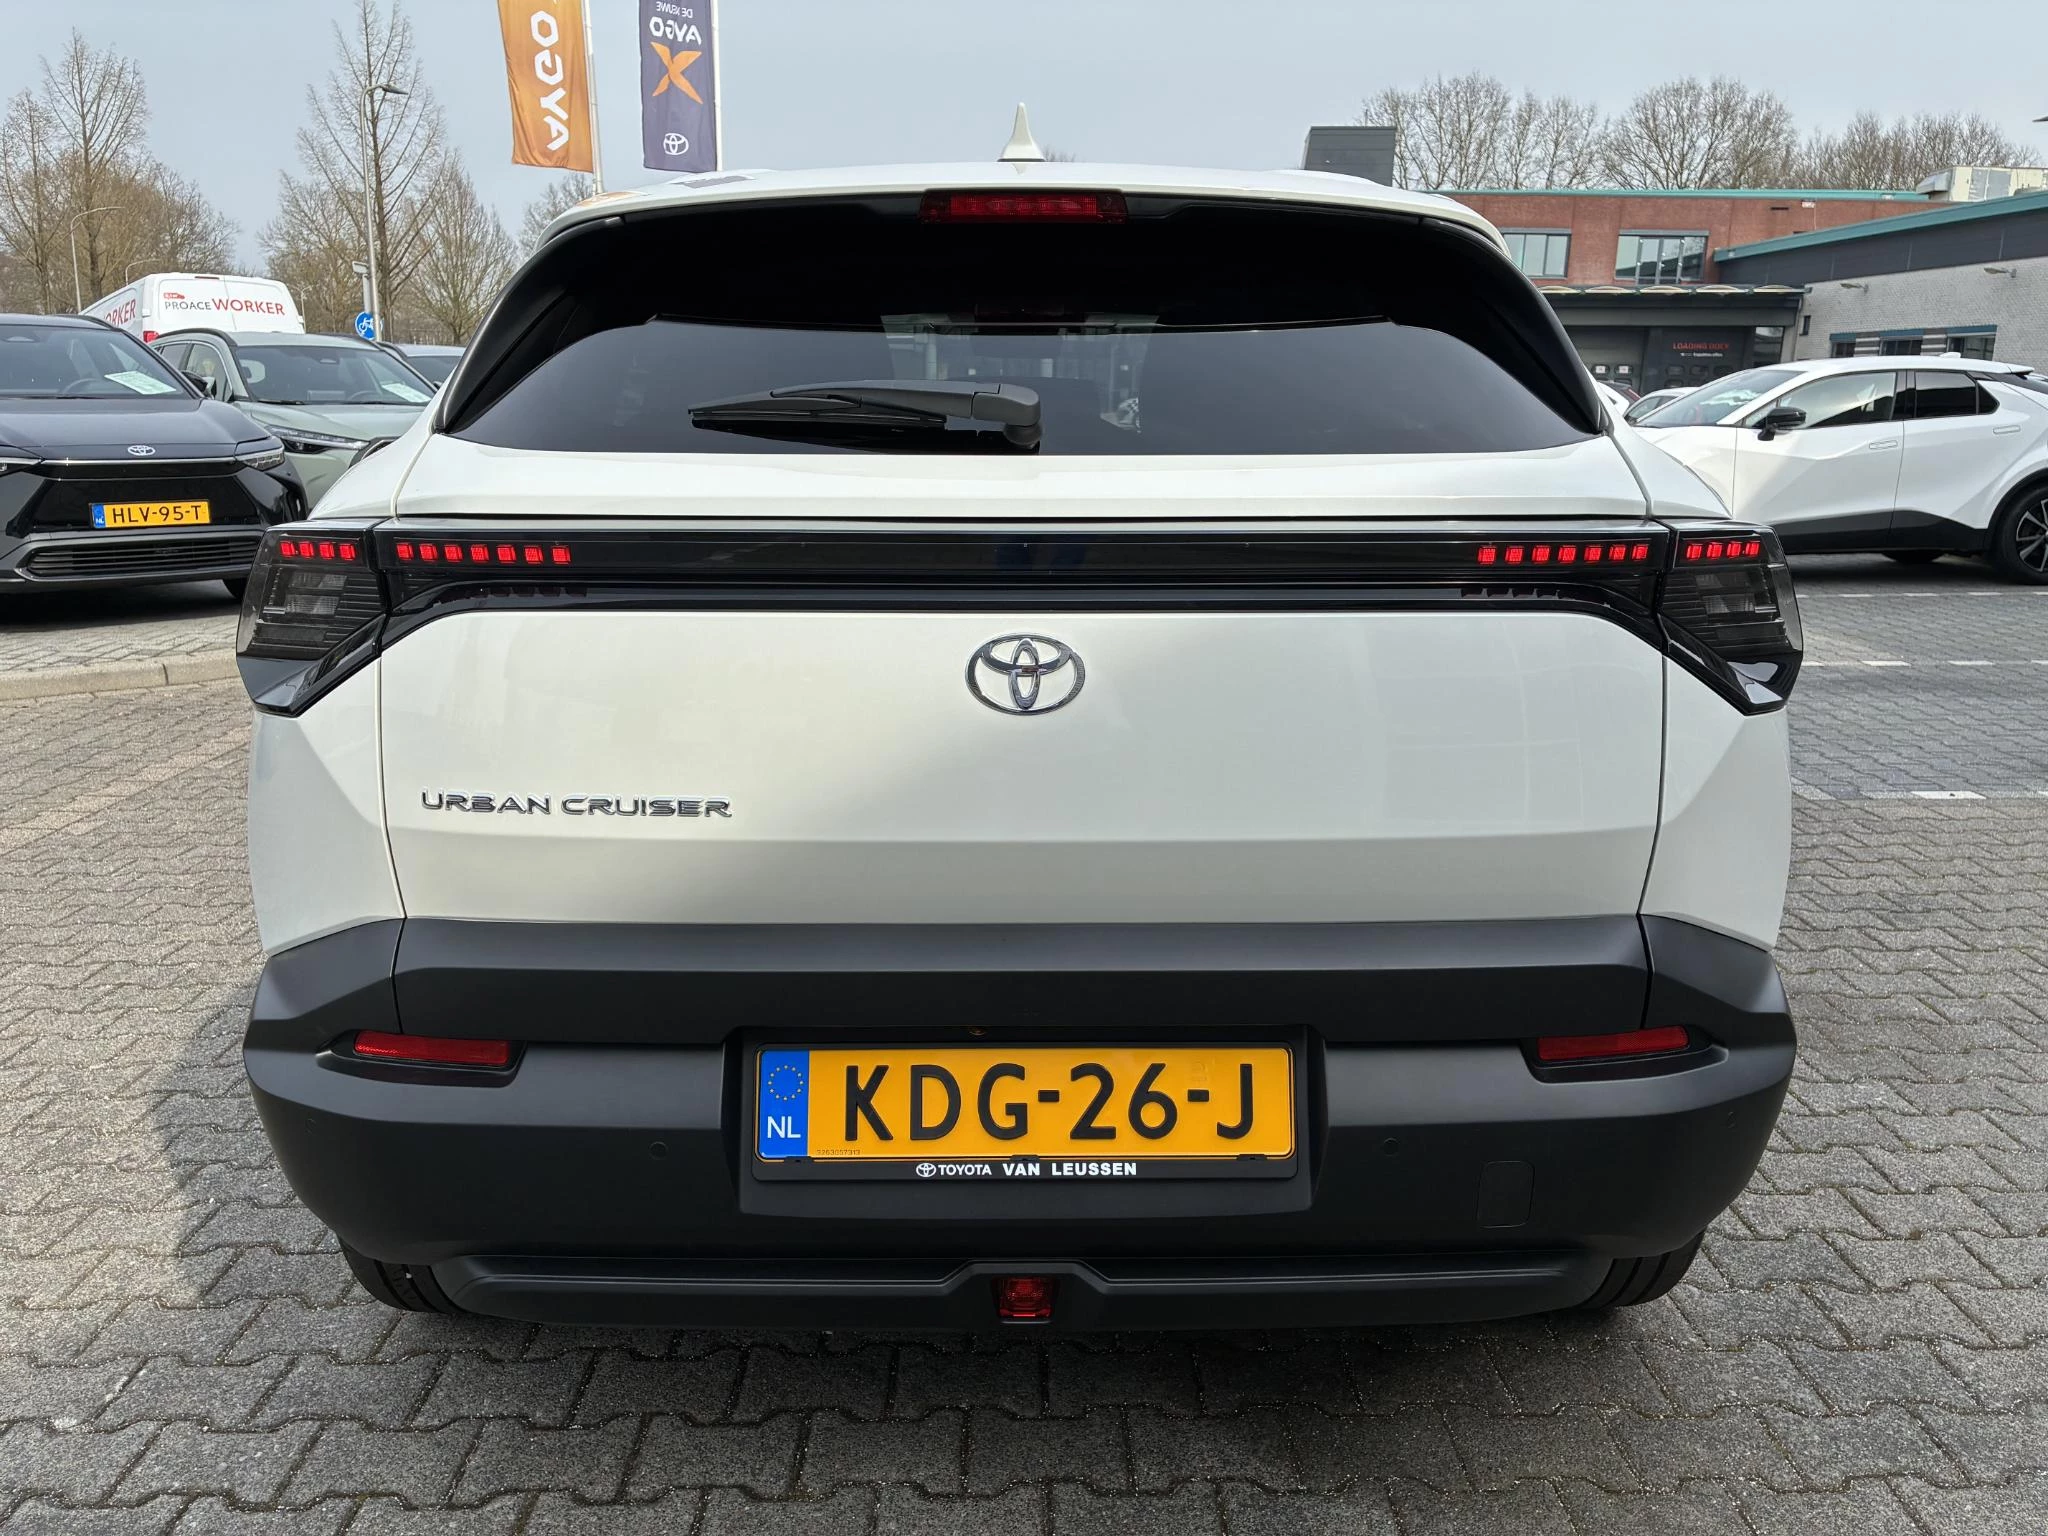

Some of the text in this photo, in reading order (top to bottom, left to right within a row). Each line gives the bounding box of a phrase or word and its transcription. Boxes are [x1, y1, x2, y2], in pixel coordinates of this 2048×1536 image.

[103, 299, 136, 327] ORKER
[165, 299, 286, 316] PROACE WORKER
[112, 505, 201, 524] HLV-95-T
[421, 789, 733, 818] URBAN CRUISER
[845, 1063, 1254, 1142] KDG-26-J
[767, 1115, 802, 1139] NL
[938, 1162, 1138, 1176] TOYOTA VAN LEUSSEN
